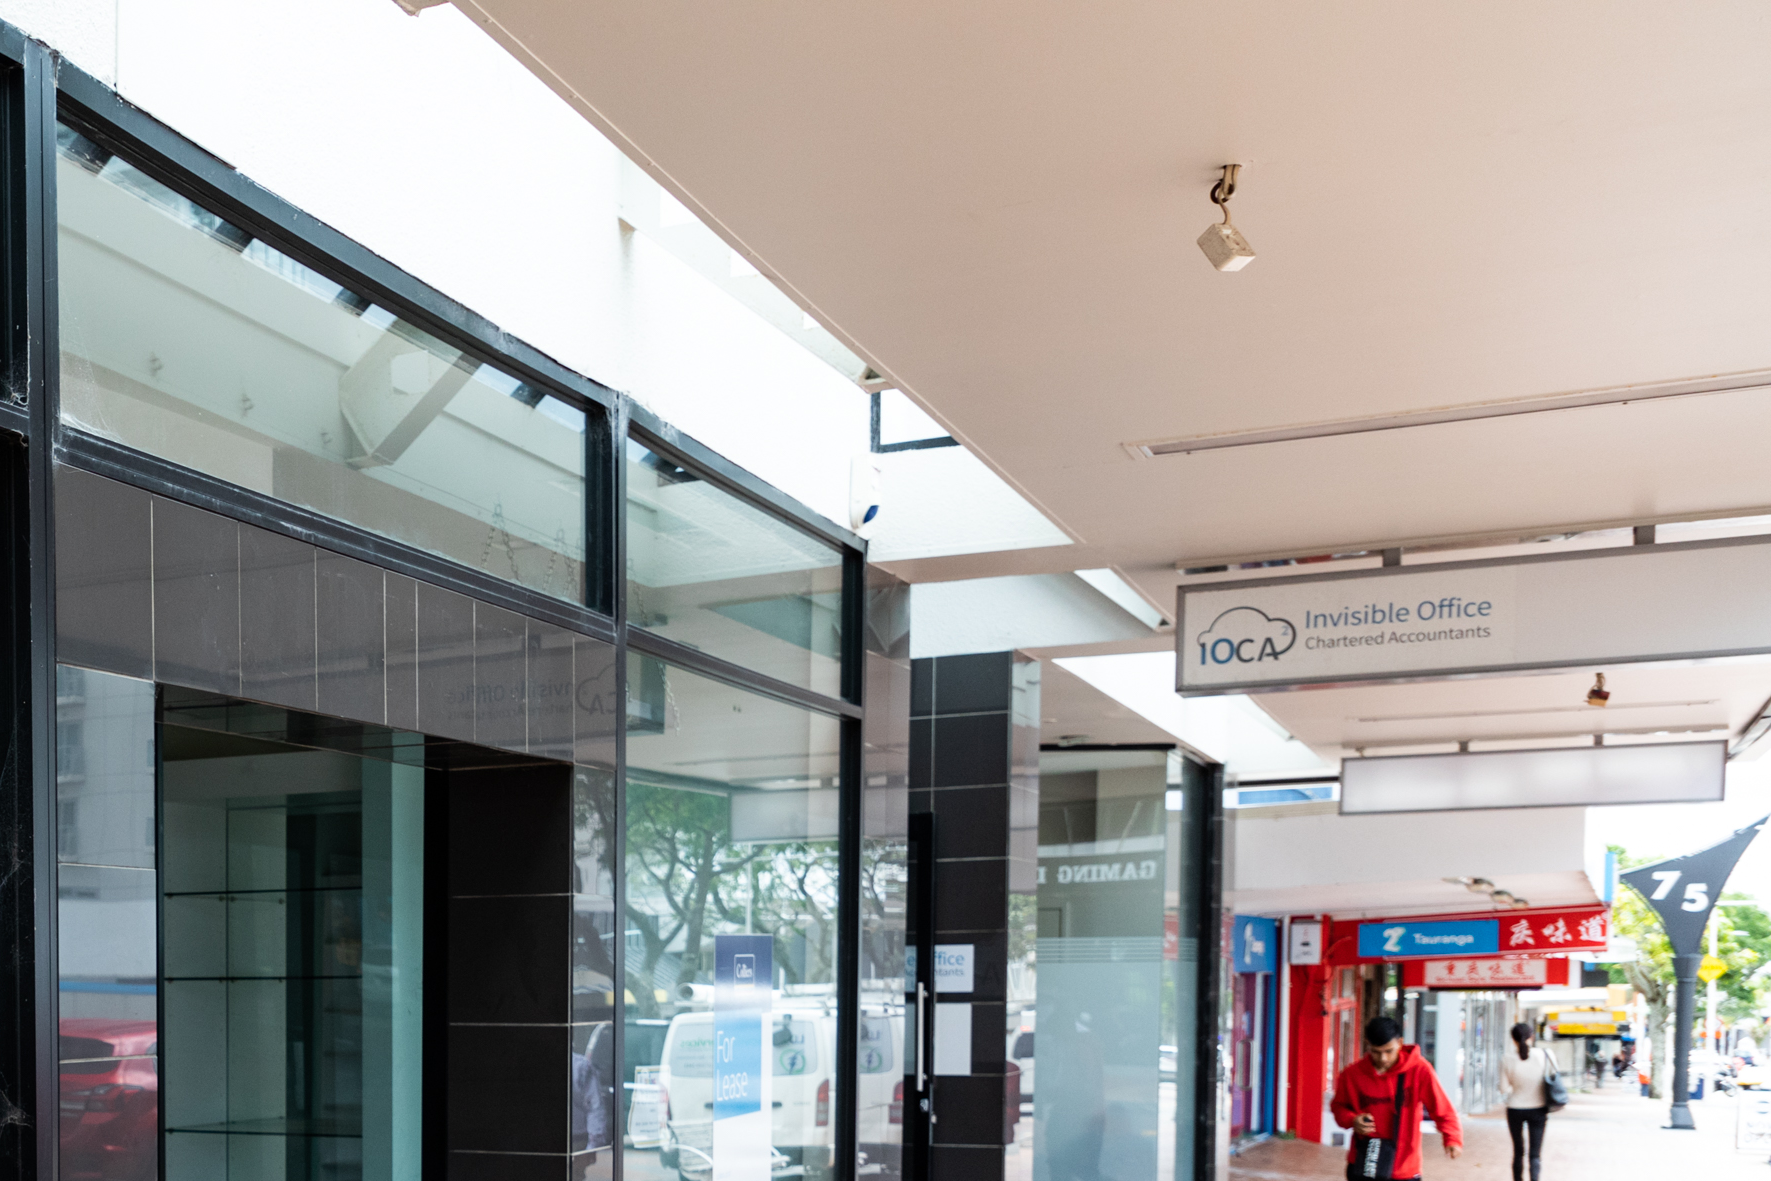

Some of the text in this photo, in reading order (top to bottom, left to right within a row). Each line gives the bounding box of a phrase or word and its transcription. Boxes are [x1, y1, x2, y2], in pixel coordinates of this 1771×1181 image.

[1305, 597, 1493, 630] Invisible Office
[1305, 624, 1492, 650] Chartered Accountants
[1413, 933, 1475, 946] Tauranga
[716, 1030, 735, 1064] For
[716, 1069, 748, 1101] Lease
